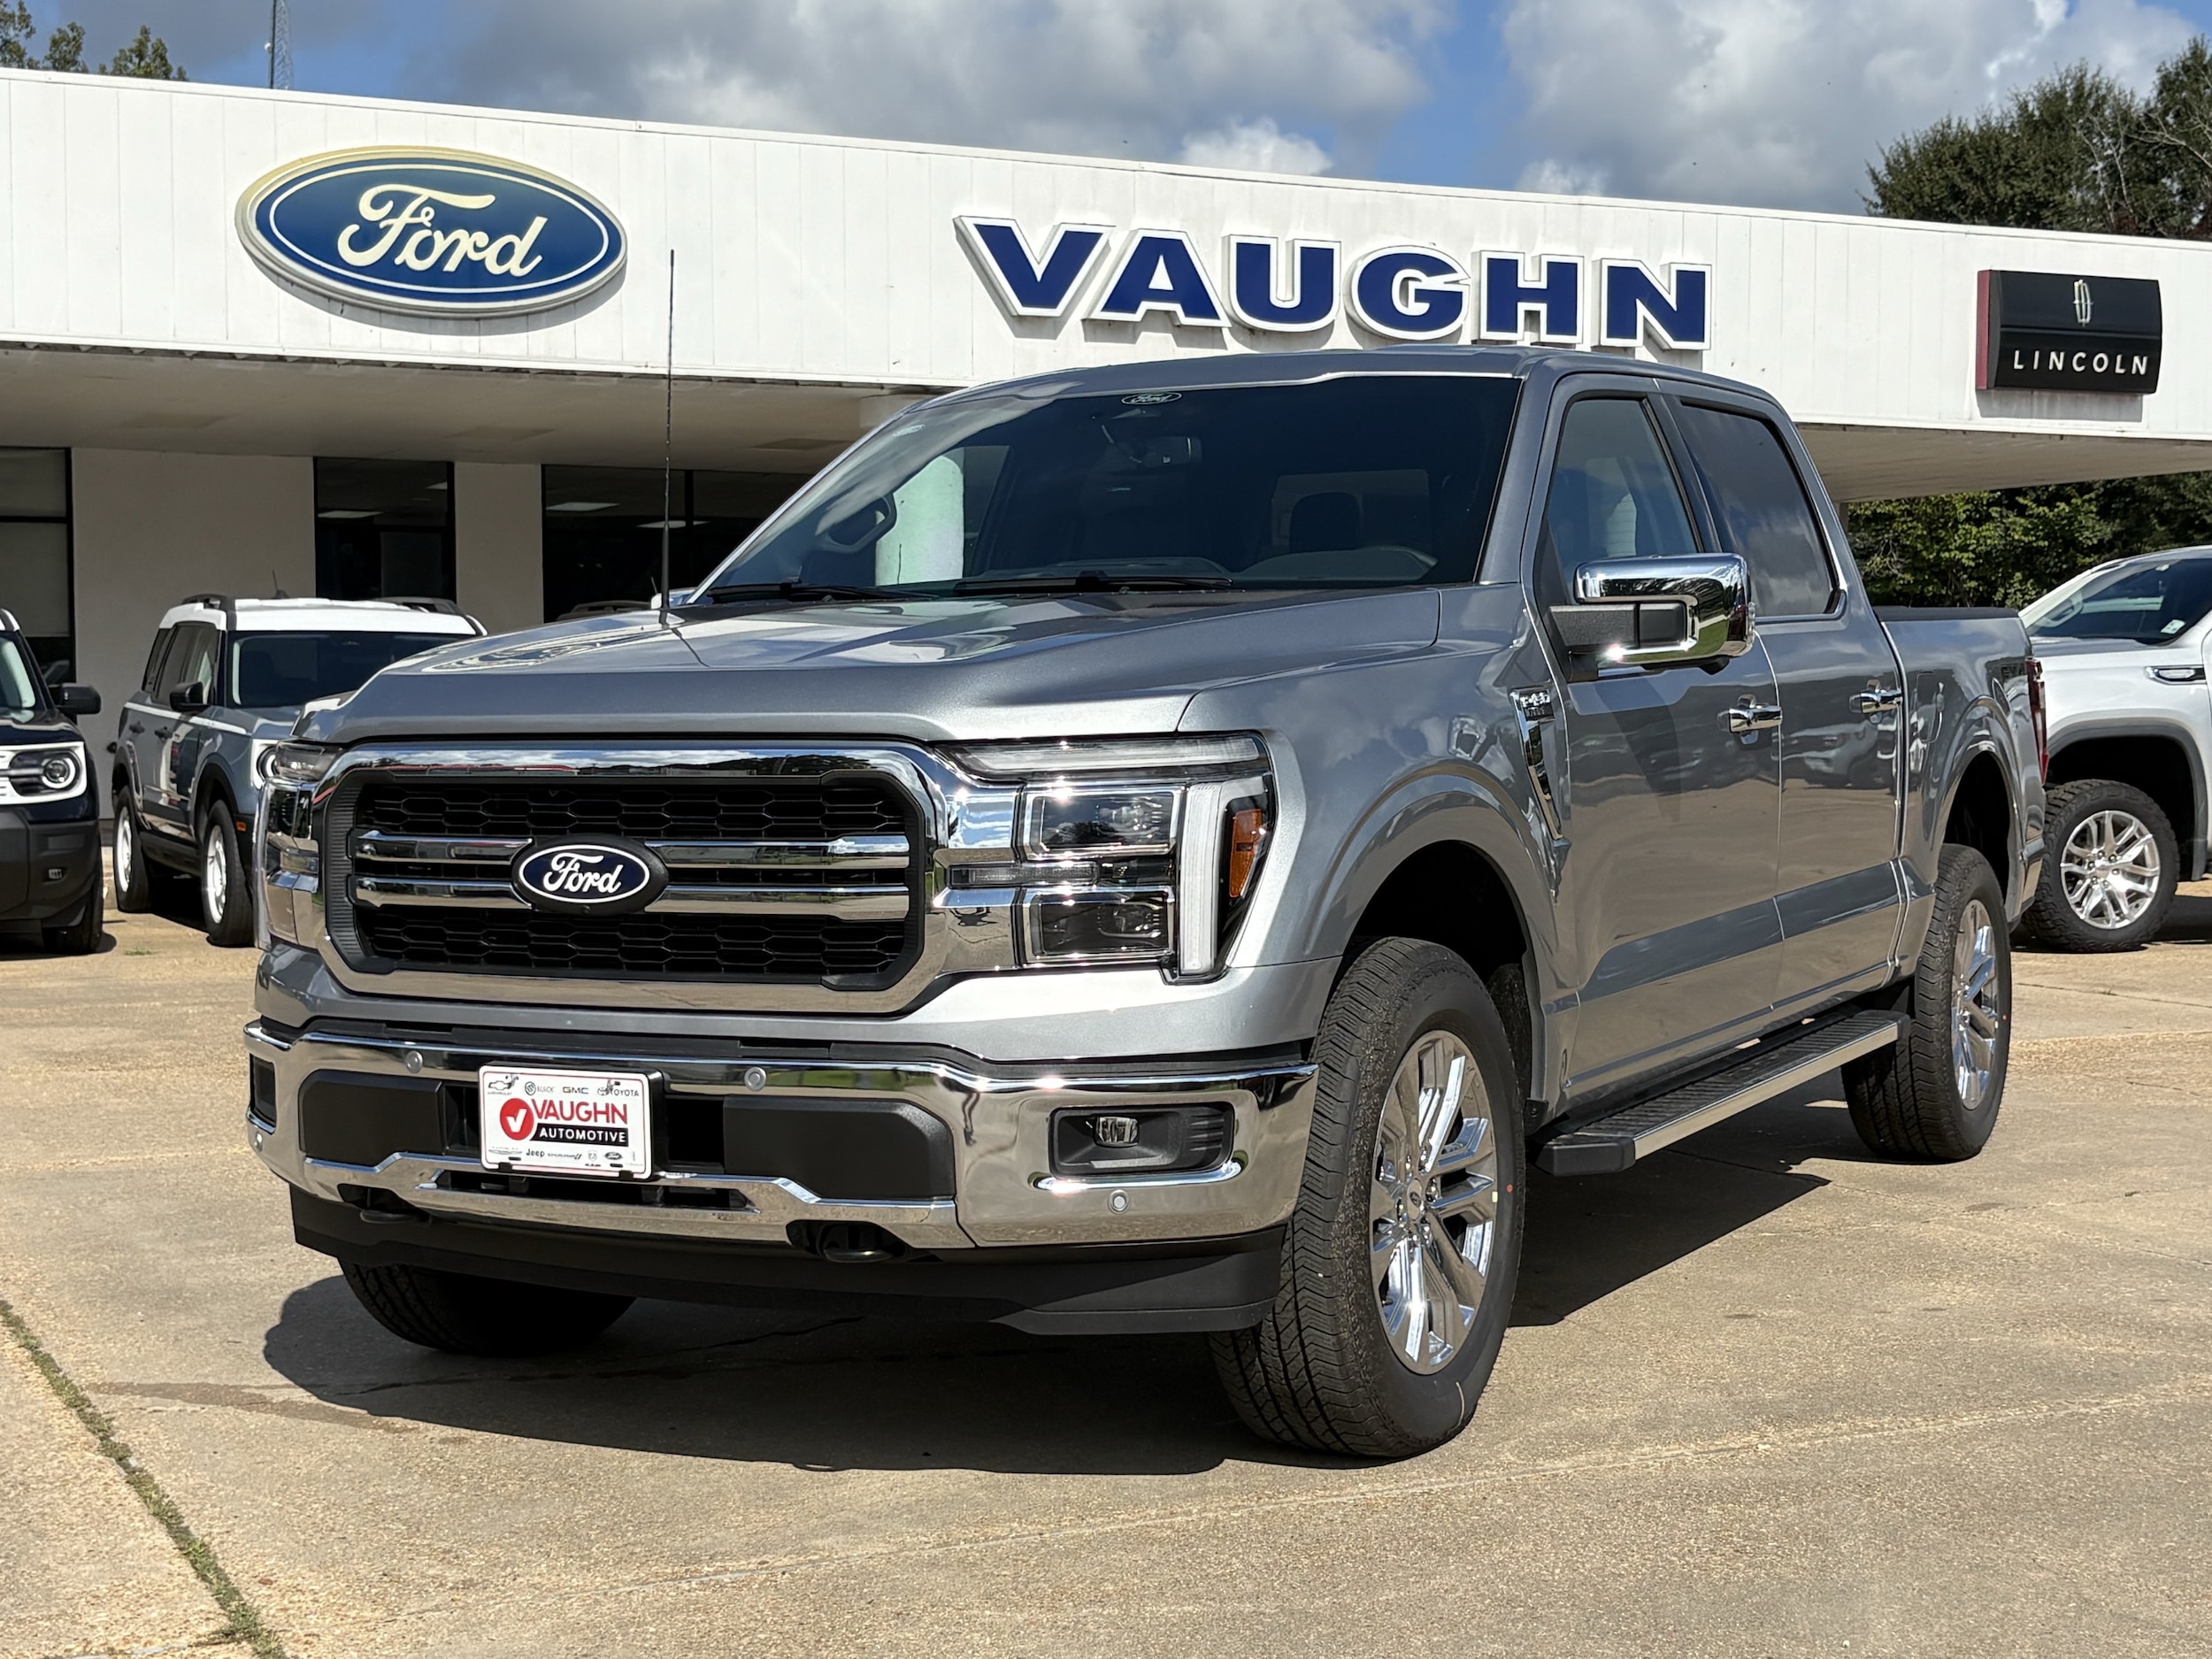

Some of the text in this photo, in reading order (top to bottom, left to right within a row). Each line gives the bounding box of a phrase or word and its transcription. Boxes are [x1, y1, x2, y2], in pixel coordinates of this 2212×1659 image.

[337, 183, 549, 277] Ford
[957, 216, 1711, 350] VAUGHN
[2013, 350, 2148, 375] LINCOLN
[543, 853, 624, 893] Ford
[531, 1099, 627, 1125] VAUGHN
[540, 1127, 626, 1142] AUTOMOTIVE
[526, 1148, 545, 1157] Jeep
